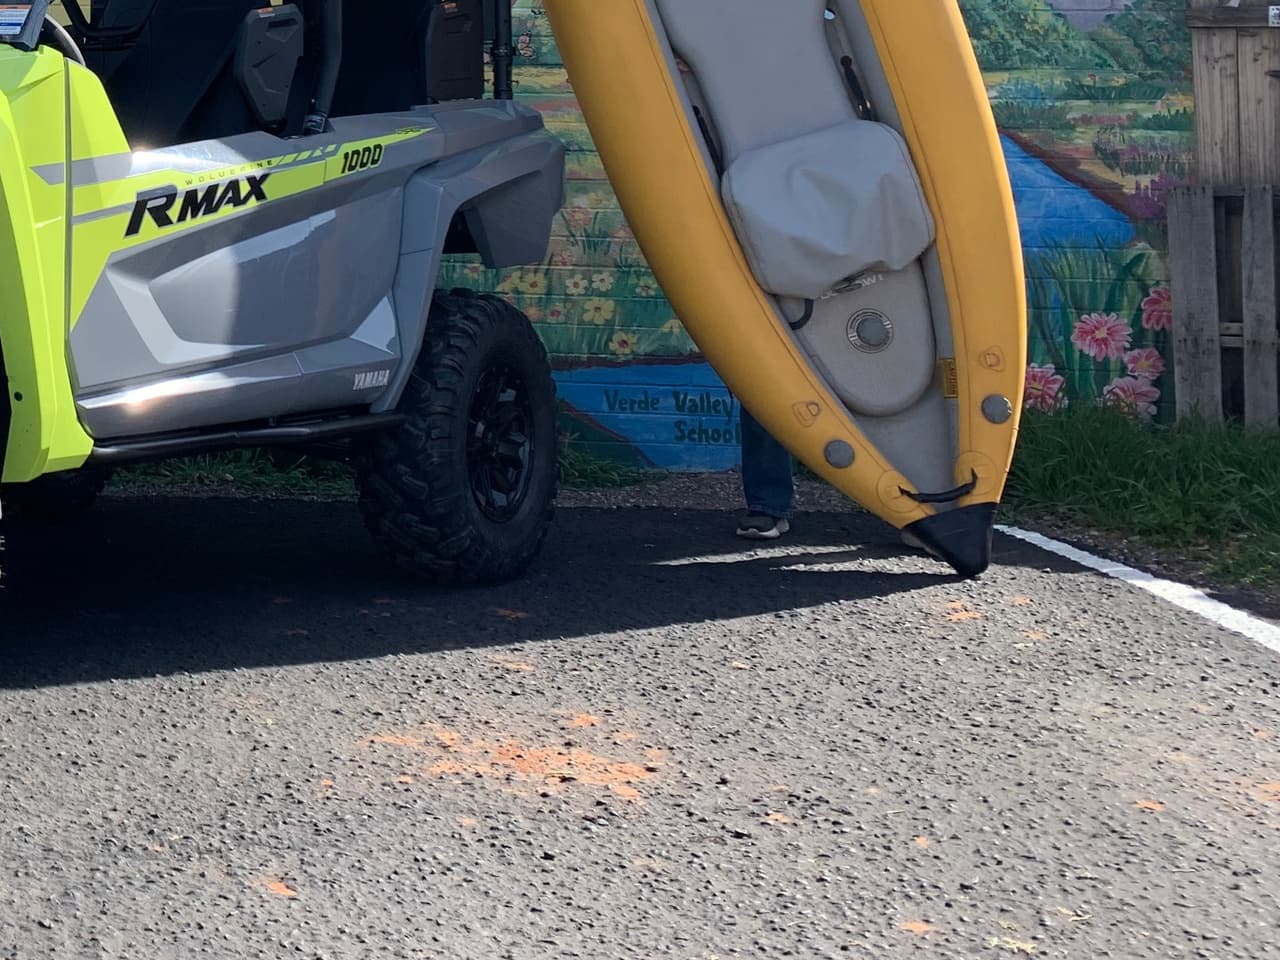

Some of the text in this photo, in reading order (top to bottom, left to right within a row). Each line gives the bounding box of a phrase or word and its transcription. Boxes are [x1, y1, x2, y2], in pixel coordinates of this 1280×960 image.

[341, 143, 383, 174] 1000
[123, 172, 269, 238] RMAX
[352, 369, 391, 391] YAMAHA
[603, 389, 735, 420] Verde Valley
[673, 419, 741, 446] School
